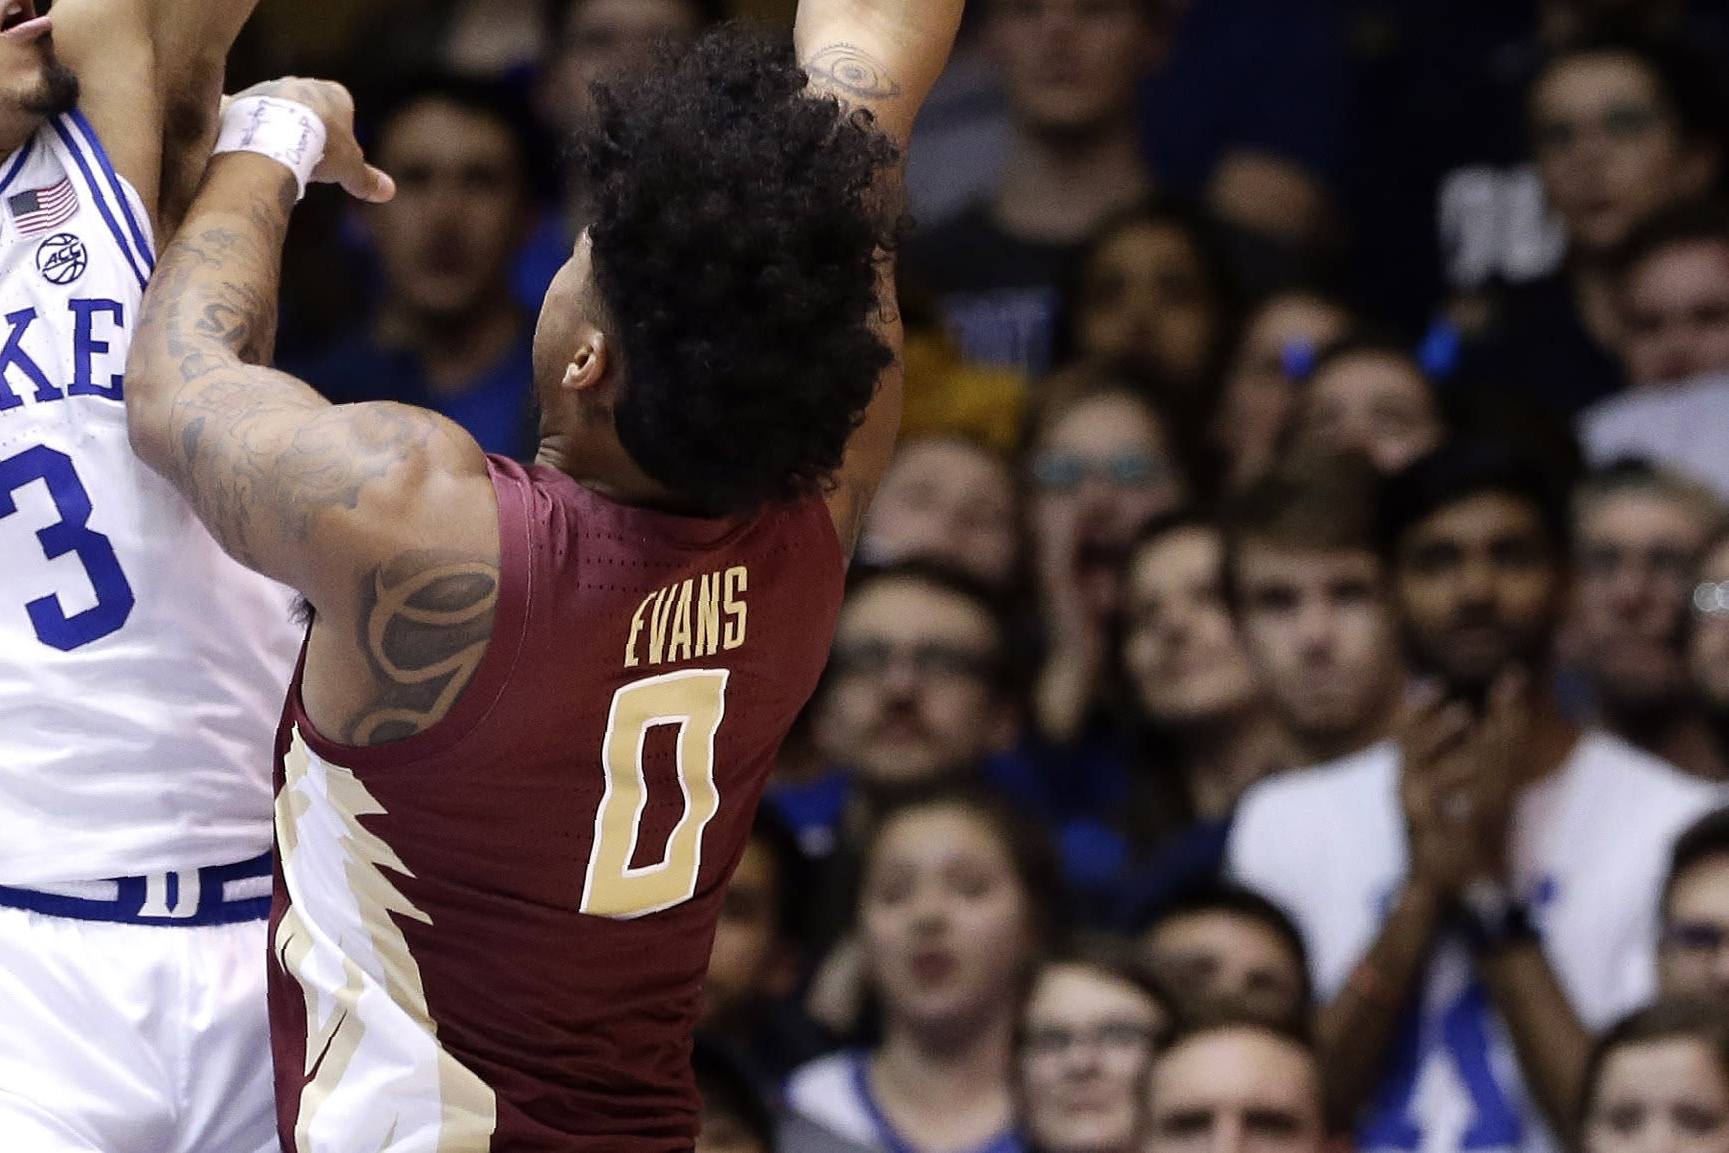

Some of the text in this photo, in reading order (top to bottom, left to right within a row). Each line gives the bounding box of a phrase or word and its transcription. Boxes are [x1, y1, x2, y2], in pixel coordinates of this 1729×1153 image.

[44, 241, 82, 268] ACC
[624, 566, 748, 668] EVANS
[579, 669, 730, 919] 0
